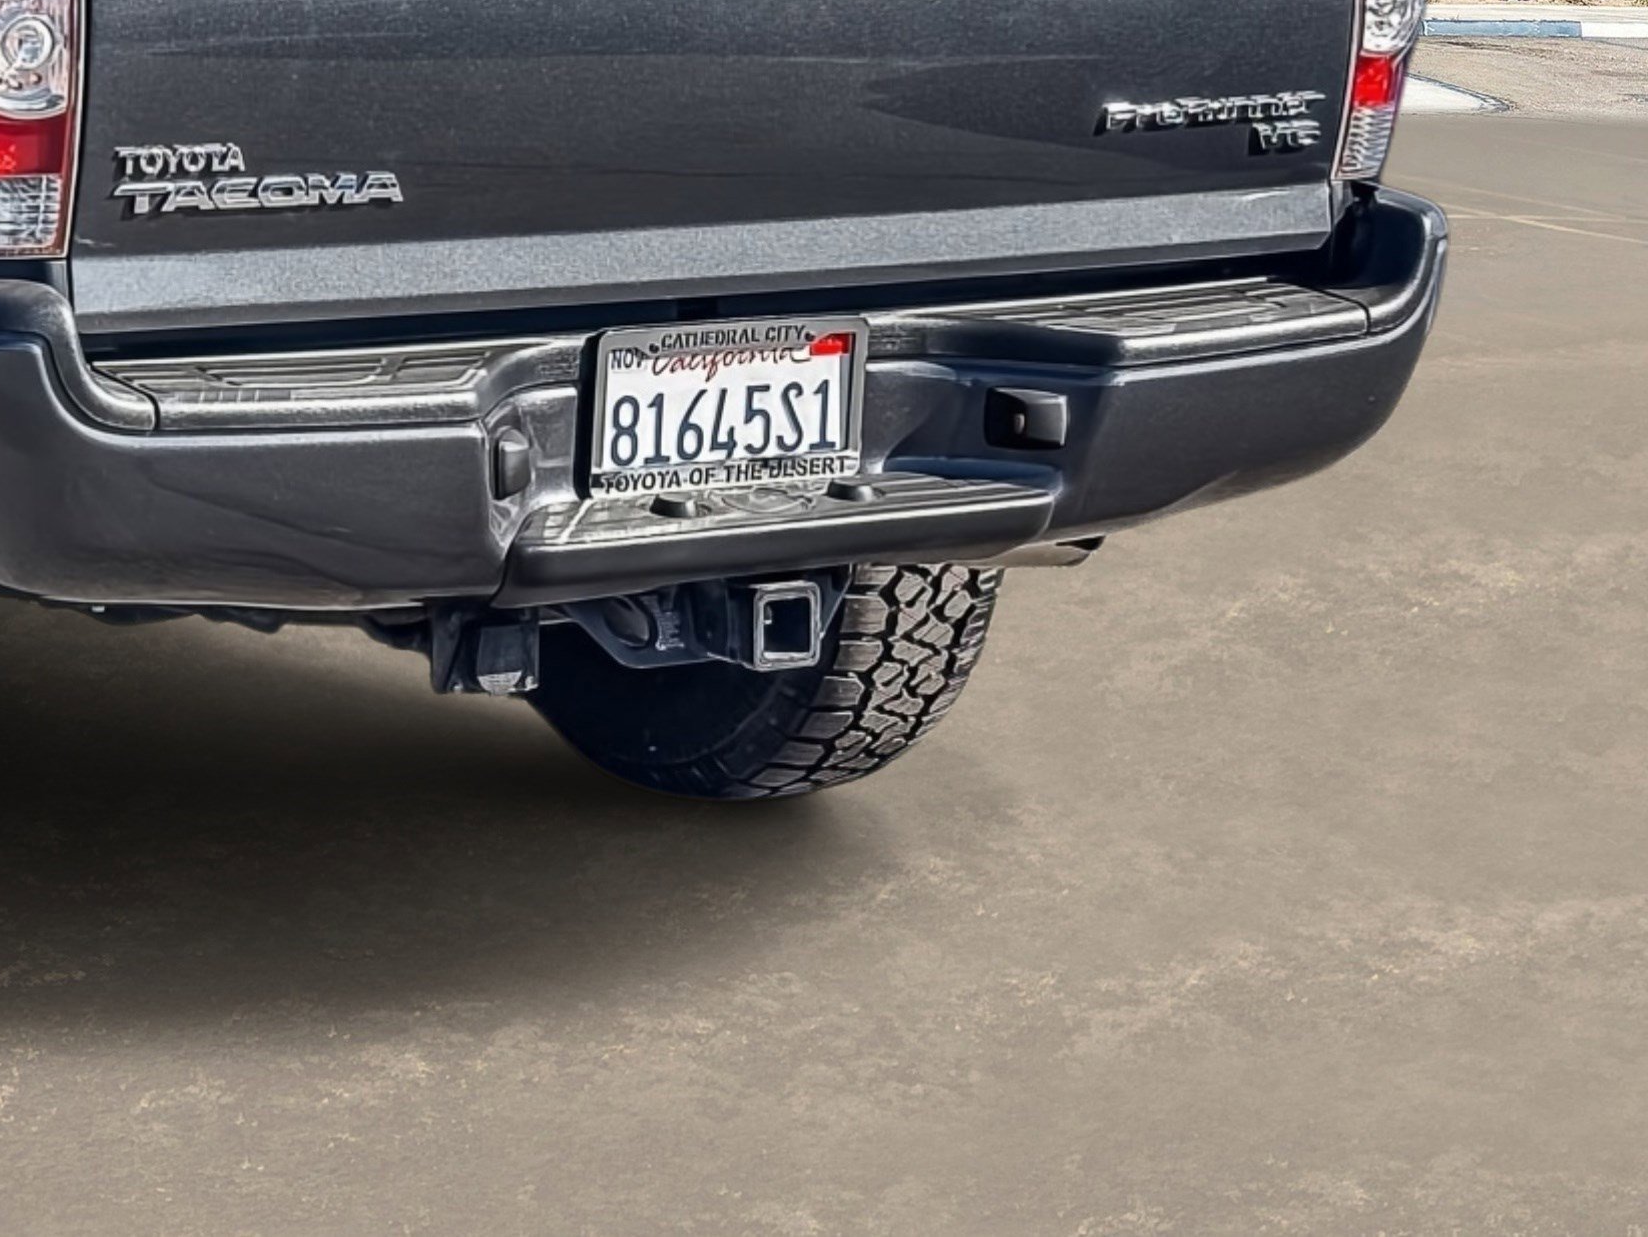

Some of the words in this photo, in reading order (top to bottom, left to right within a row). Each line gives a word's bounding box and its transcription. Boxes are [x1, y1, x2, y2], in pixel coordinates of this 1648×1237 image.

[114, 143, 245, 175] TOYOTA
[114, 171, 403, 214] TACOMA
[661, 330, 760, 353] CATHEDRAL
[765, 325, 806, 344] CITY
[610, 378, 837, 466] 81645S1
[603, 470, 681, 494] TOYOTA
[689, 467, 715, 485] OF
[724, 462, 763, 483] THE
[769, 455, 848, 479] DESERT
